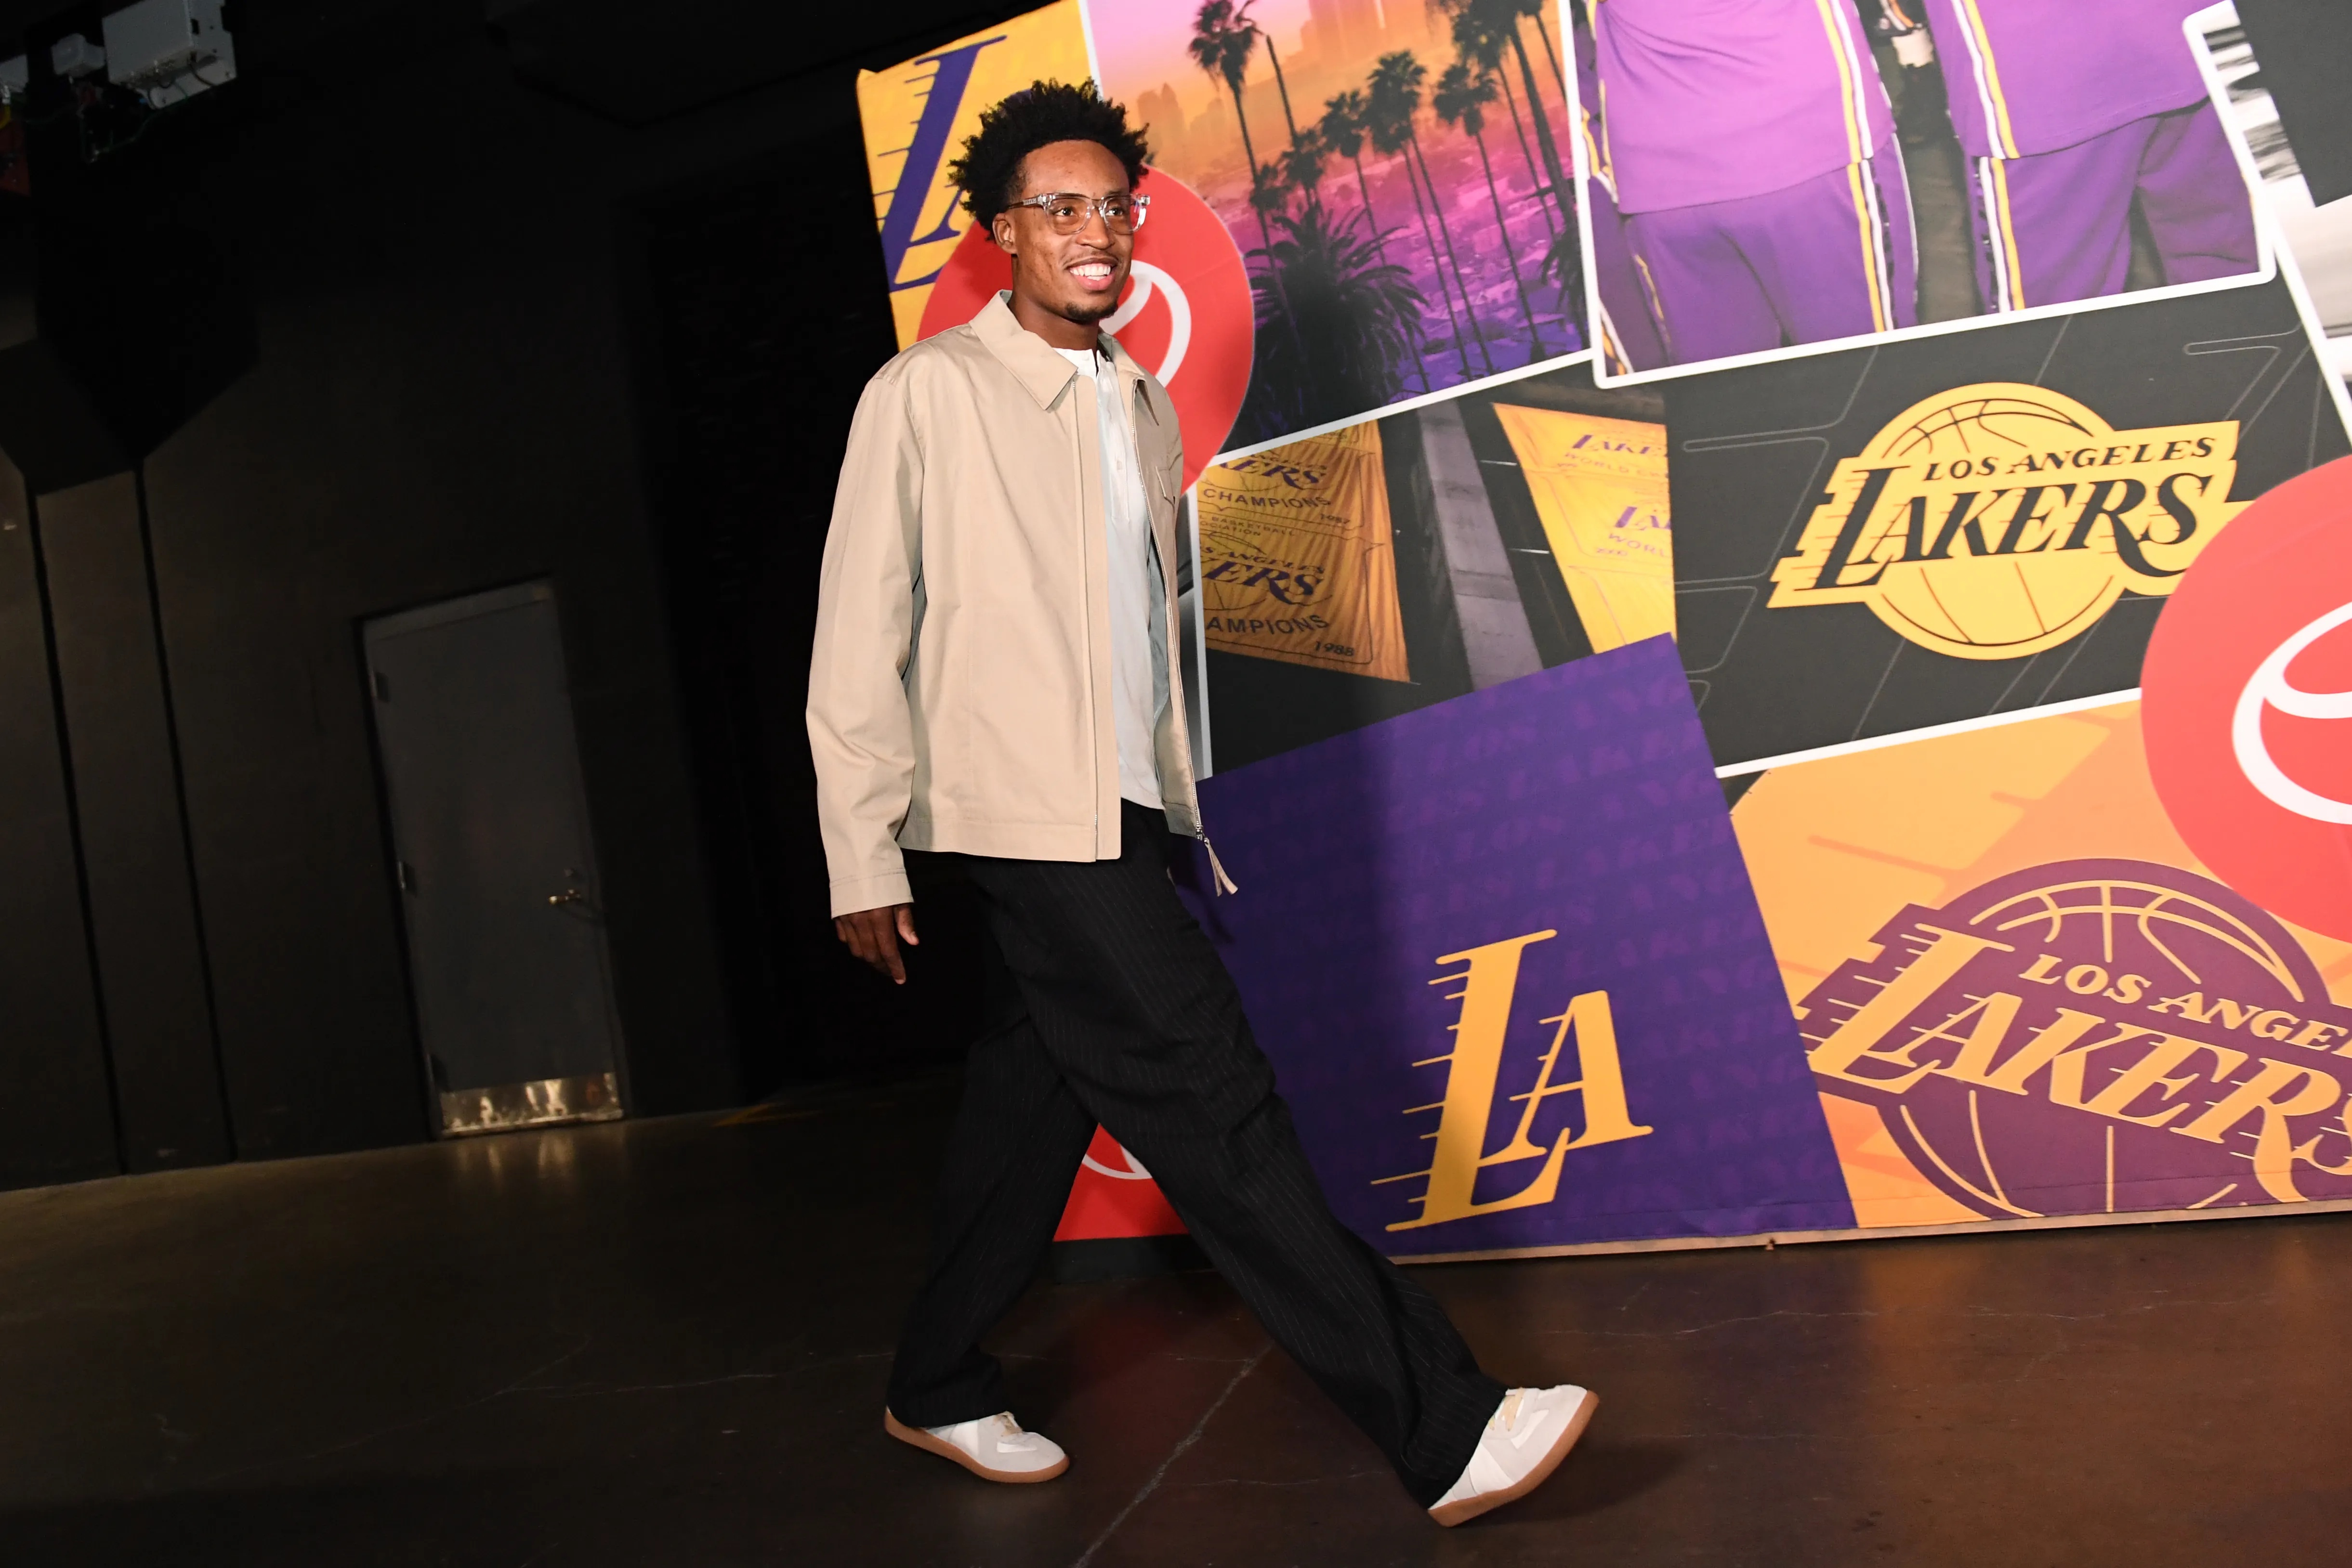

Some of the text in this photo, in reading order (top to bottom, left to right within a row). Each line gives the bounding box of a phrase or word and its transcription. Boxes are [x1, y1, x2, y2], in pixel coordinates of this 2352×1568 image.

[1923, 436, 2217, 482] LOS ANGELES
[1203, 487, 1332, 509] CHAMPIONS
[1792, 465, 2217, 590] LAKERS
[2018, 954, 2153, 1004] LOS
[1371, 928, 1654, 1232] LA
